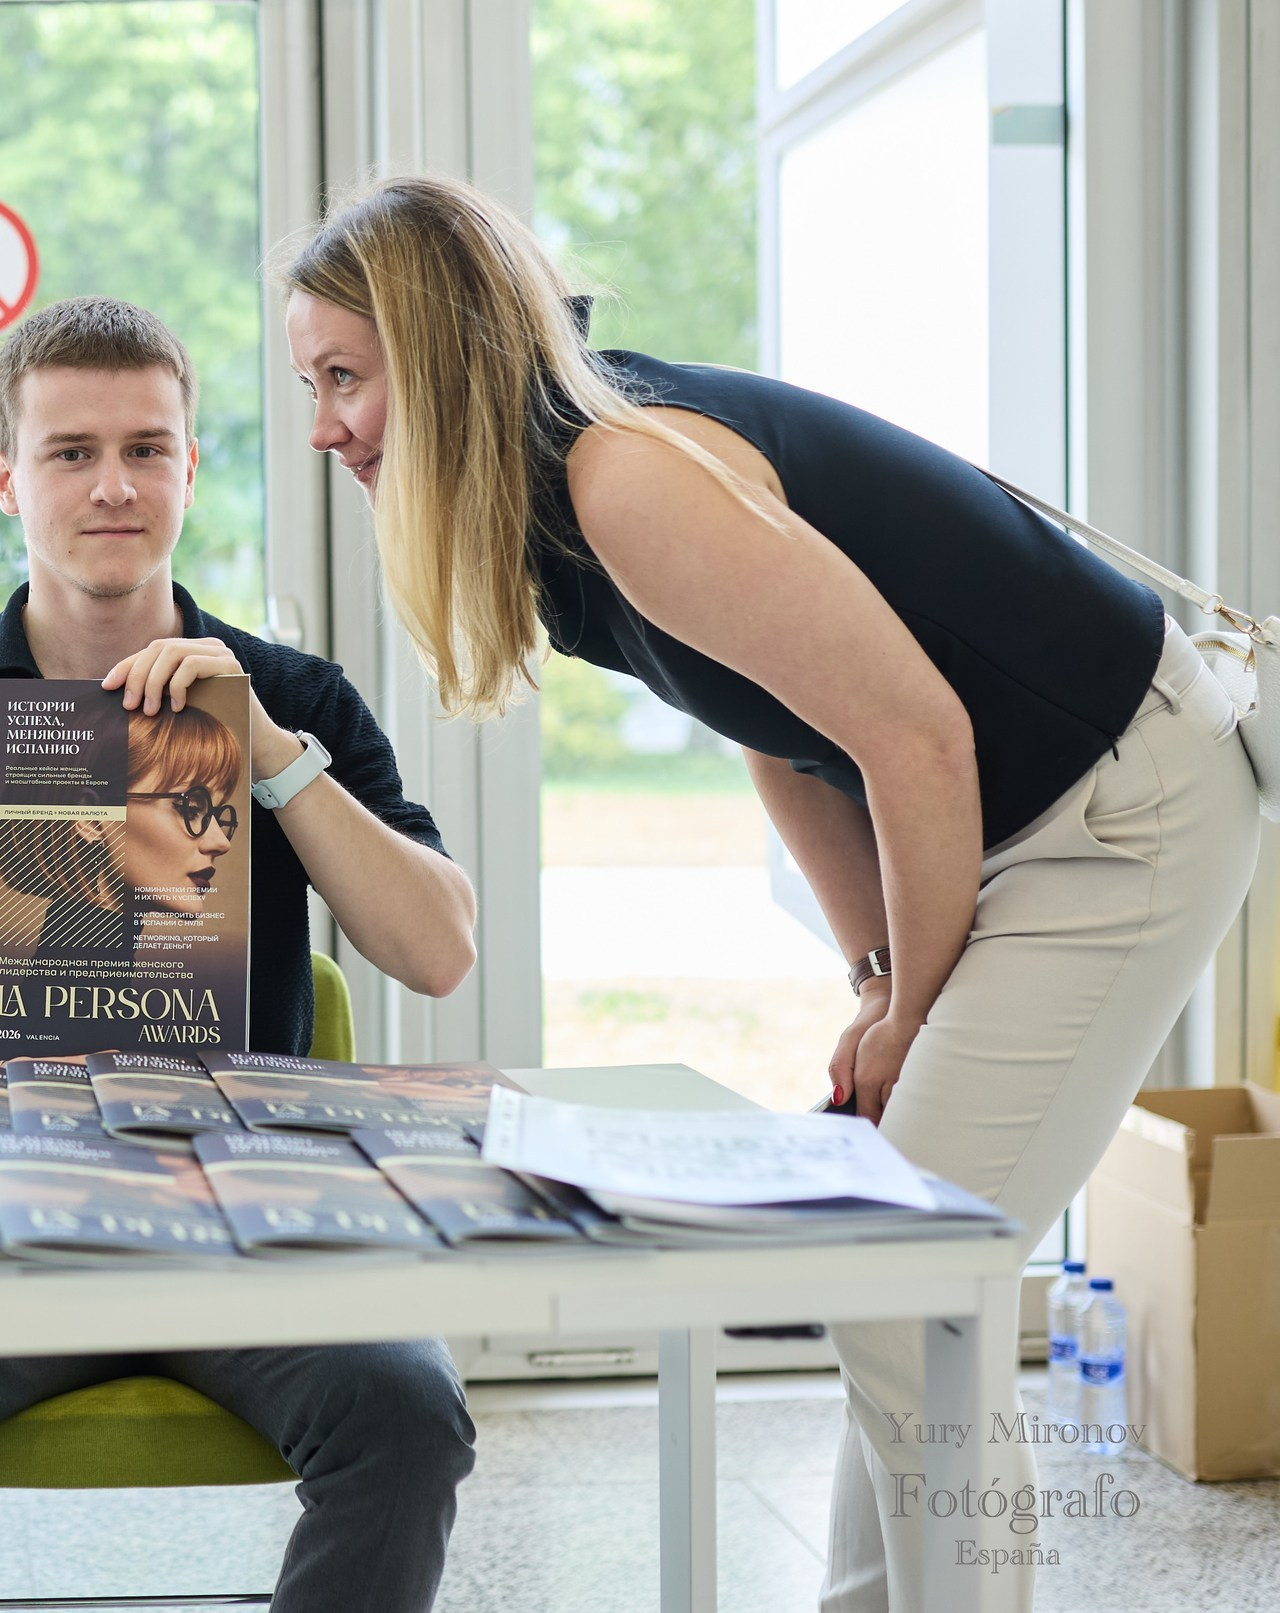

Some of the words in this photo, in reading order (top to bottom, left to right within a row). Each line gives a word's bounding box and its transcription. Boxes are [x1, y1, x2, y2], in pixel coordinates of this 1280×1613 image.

[7, 701, 76, 712] ИСТОРИИ
[7, 715, 65, 727] УСПЕХА,
[6, 729, 95, 742] МЕНЯЮЩИЕ
[6, 743, 80, 755] ИСПАНИЮ
[183, 934, 219, 942] КОТОРЫЙ
[90, 960, 130, 969] премия
[132, 960, 185, 969] женского
[68, 970, 194, 980] предприеимательства
[44, 985, 221, 1021] PERSONA
[137, 1024, 221, 1044] AWARDS
